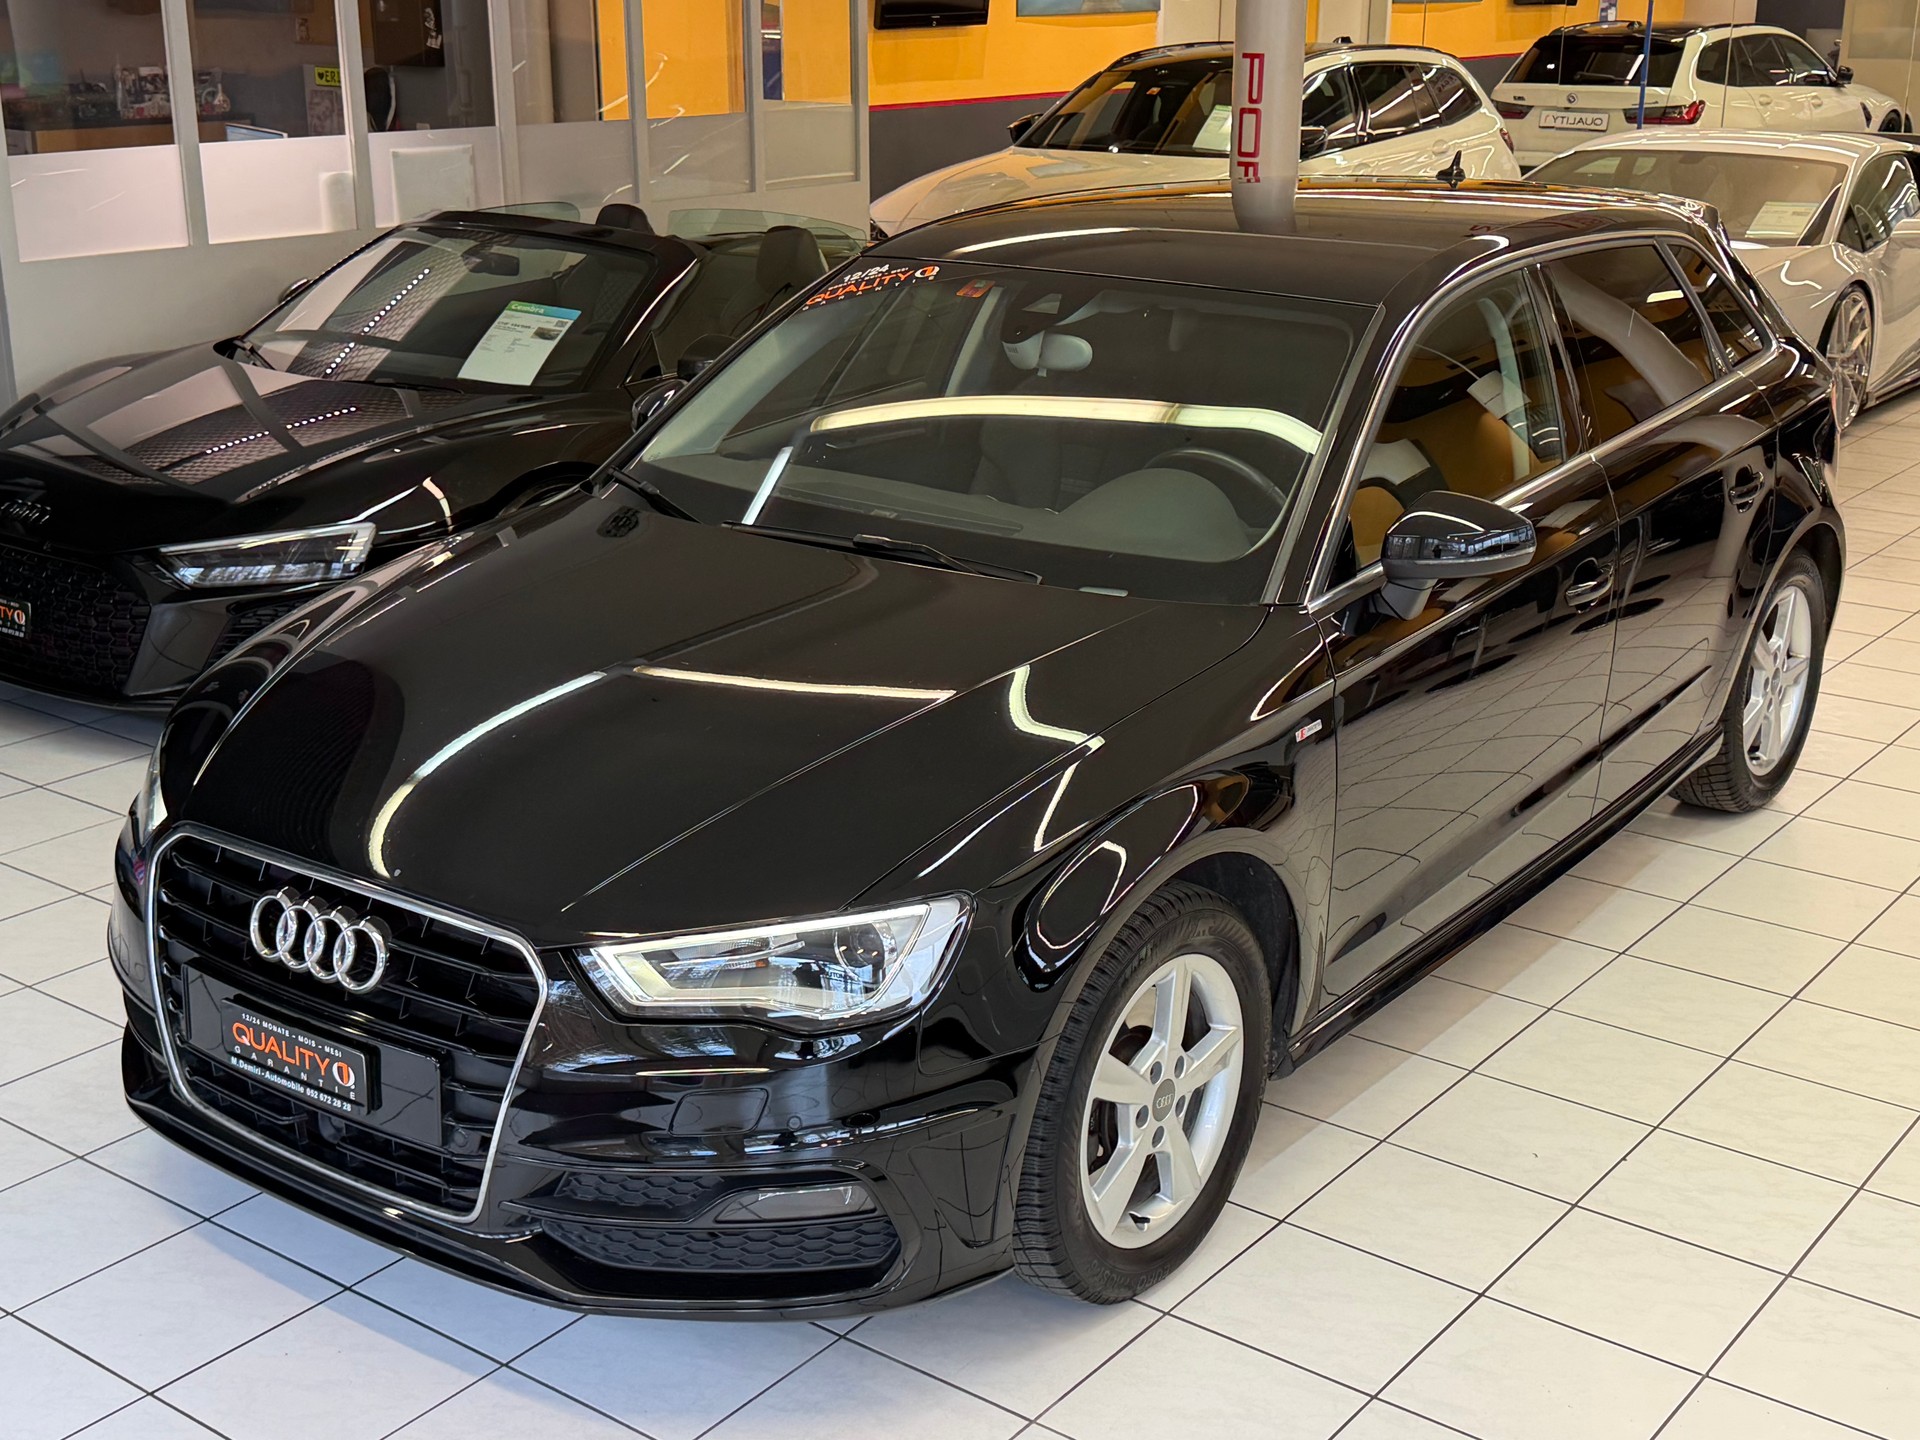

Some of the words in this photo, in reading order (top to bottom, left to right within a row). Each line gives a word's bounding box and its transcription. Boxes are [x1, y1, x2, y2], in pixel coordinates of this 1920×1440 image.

[806, 270, 915, 306] QUALITY
[843, 264, 890, 283] 12/24
[232, 1022, 330, 1076] QUALITY
[241, 1013, 261, 1026] 12/24
[262, 1021, 290, 1038] MONATE
[298, 1034, 316, 1048] MOIS
[324, 1045, 342, 1058] MESI
[264, 1072, 305, 1094] Automobile
[306, 1087, 318, 1099] 052
[319, 1093, 332, 1105] 672
[332, 1098, 342, 1108] 28
[342, 1101, 351, 1112] 28
